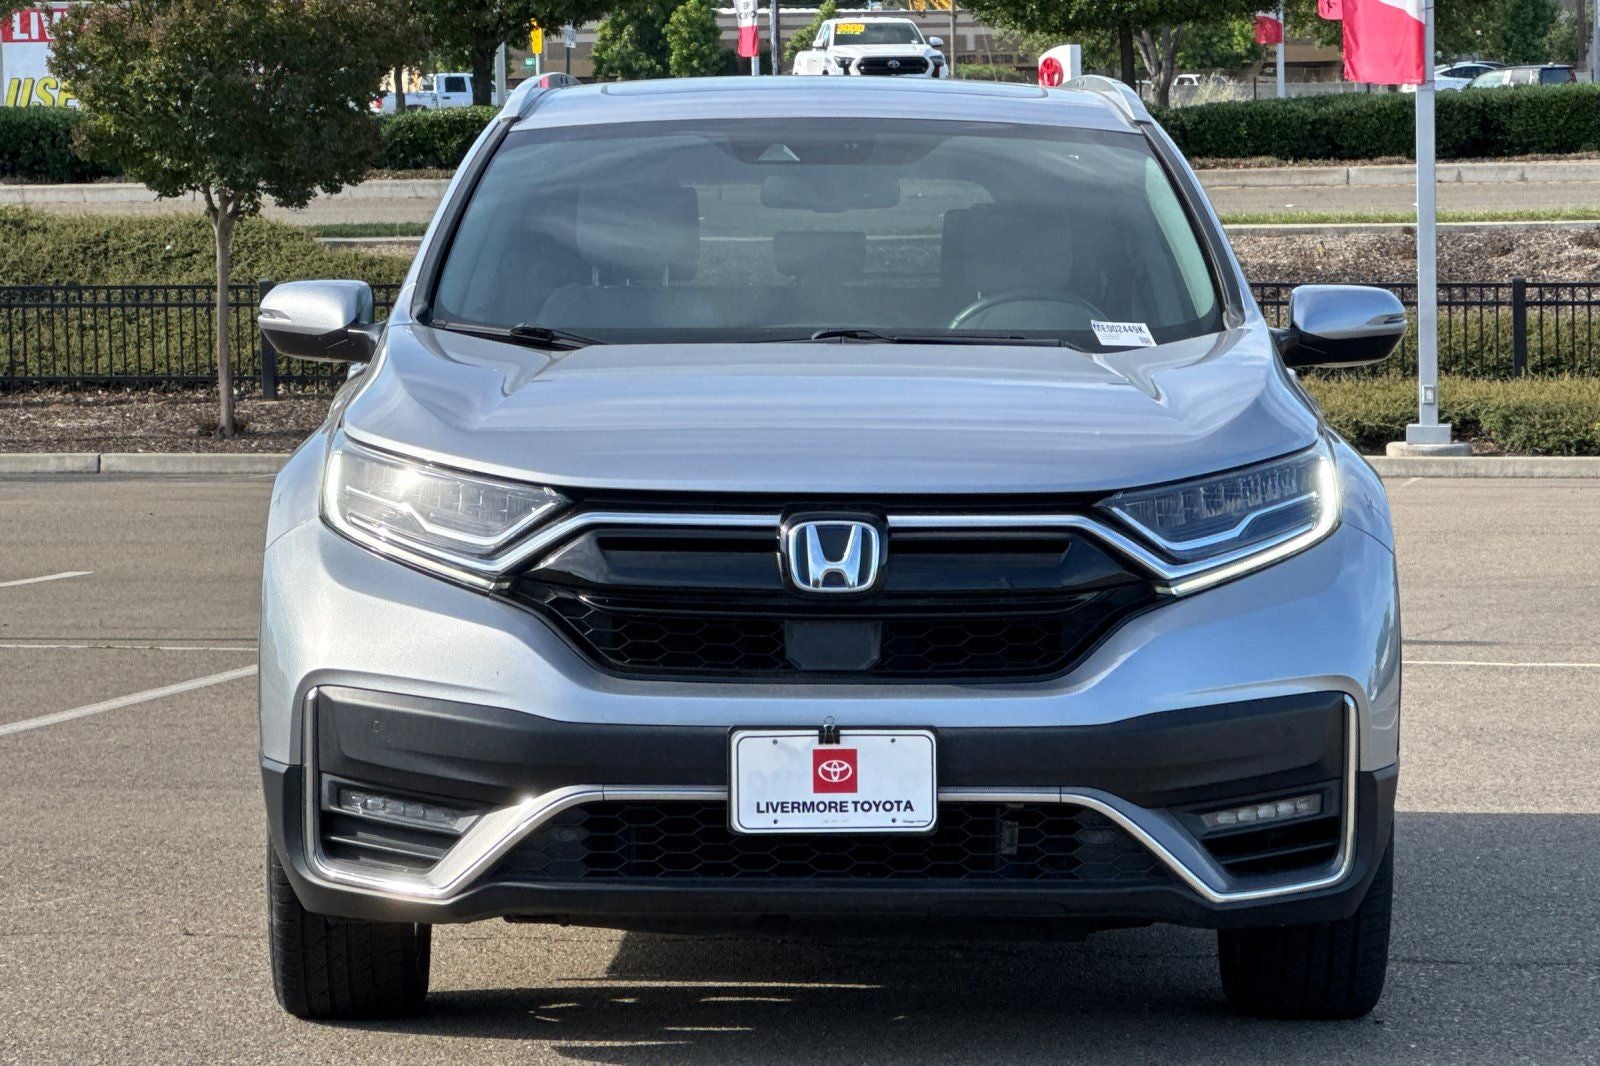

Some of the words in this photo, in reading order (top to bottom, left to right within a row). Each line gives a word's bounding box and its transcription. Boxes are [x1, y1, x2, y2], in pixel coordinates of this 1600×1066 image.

[12, 11, 68, 40] LIV
[756, 800, 849, 814] LIVERMORE
[852, 799, 914, 812] TOYOTA
